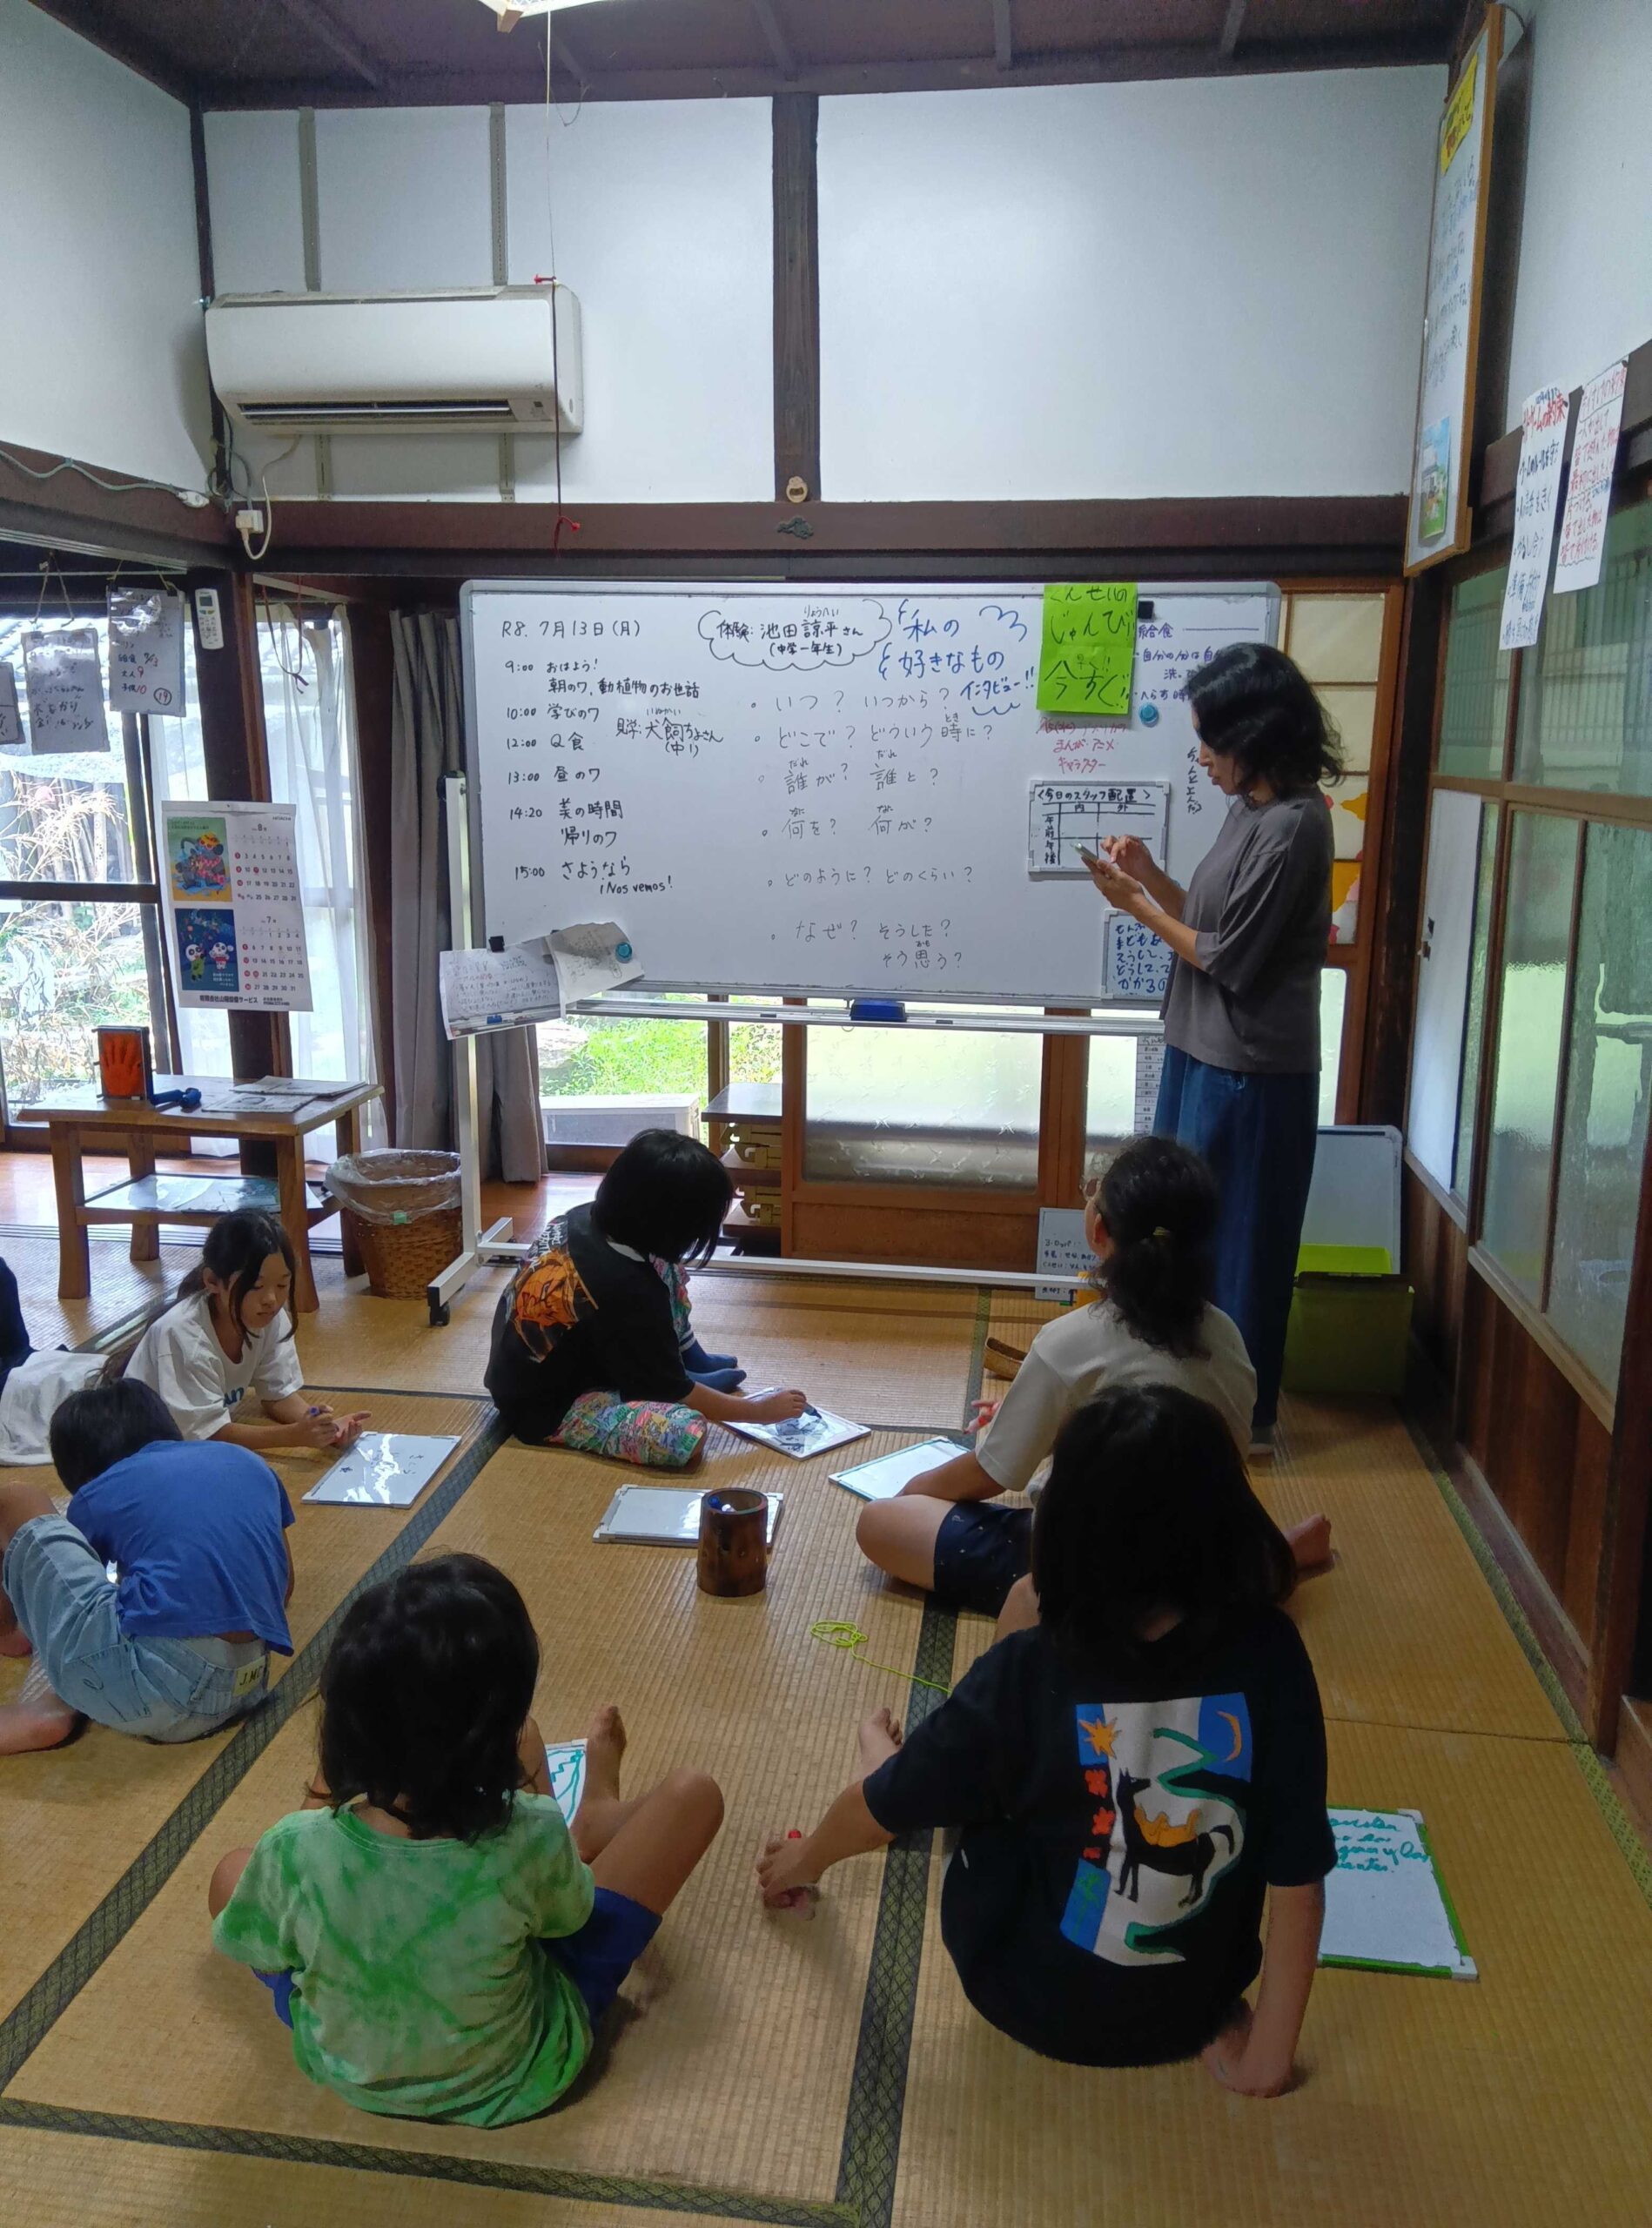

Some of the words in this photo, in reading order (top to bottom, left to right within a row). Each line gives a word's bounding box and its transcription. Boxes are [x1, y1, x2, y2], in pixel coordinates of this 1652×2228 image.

[903, 609, 959, 642] 私の
[769, 641, 843, 657] (中学一年生)
[505, 661, 534, 674] 9:00
[547, 659, 598, 674] おはよう!
[898, 645, 1004, 678] 好きなもの
[776, 690, 844, 713] いつ?
[865, 688, 950, 710] いつから?
[507, 708, 536, 720] 10:00
[944, 713, 959, 722] とき
[507, 737, 537, 749] 12:00
[779, 725, 856, 748] どこで?
[508, 771, 540, 784] 13:00
[784, 762, 848, 795] 誰が?
[870, 762, 938, 790] 誰と?
[510, 809, 542, 820] 14:20
[559, 797, 624, 820] 美の時間
[1118, 804, 1128, 813] 外
[782, 818, 836, 839] 何を?
[870, 815, 932, 836] 何が?
[515, 865, 545, 880] 15:00
[561, 856, 630, 880] さようなら
[785, 866, 871, 887] どのように?
[886, 866, 972, 883] どのくらい?
[633, 876, 673, 894] vemos!
[796, 919, 857, 942] なぜ?
[880, 919, 950, 940] そうした?
[883, 950, 962, 970] そう思う?
